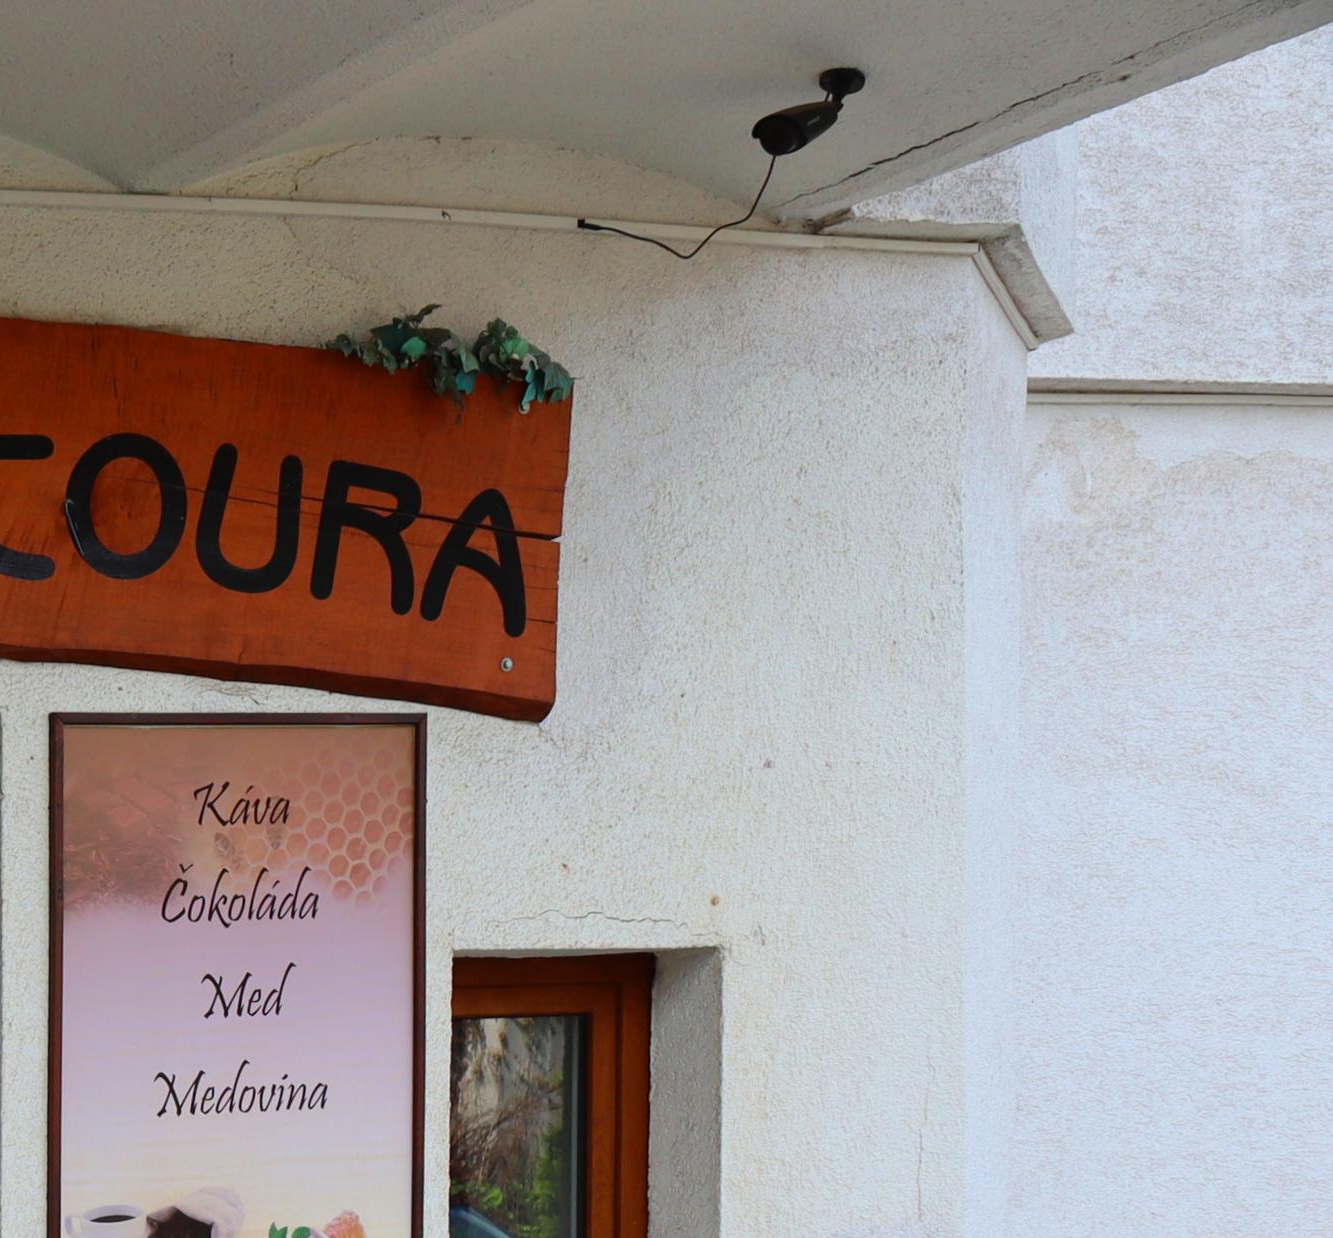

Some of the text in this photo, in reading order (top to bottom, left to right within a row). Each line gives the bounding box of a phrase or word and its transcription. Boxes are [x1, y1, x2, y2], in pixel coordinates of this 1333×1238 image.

[193, 781, 290, 827] Káva
[161, 864, 319, 928] Čokoláda
[201, 962, 294, 1018] Med
[153, 1059, 328, 1118] Medovina
